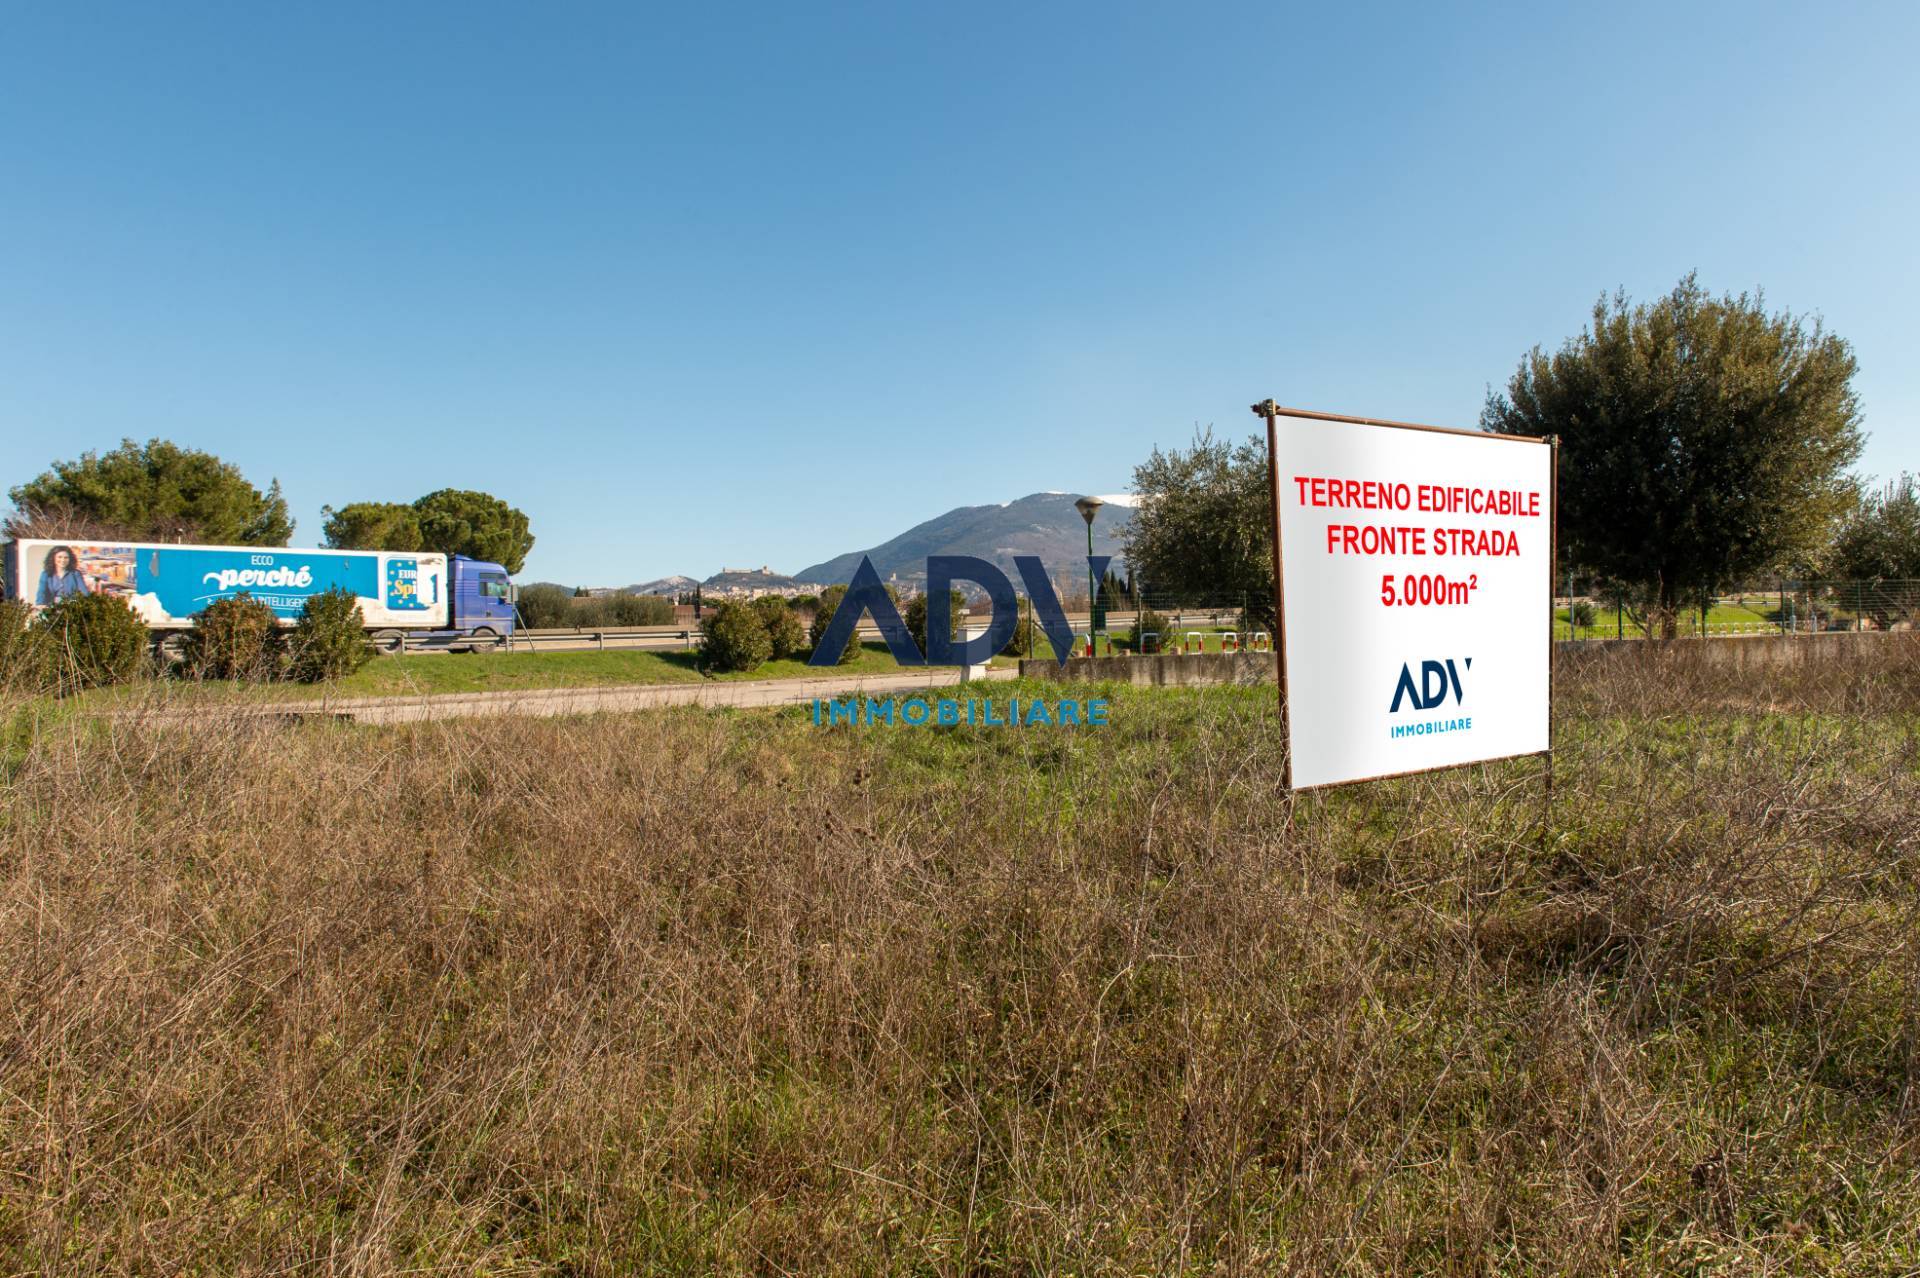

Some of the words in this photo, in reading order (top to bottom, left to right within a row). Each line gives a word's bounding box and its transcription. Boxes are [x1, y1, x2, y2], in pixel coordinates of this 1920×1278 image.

[1294, 477, 1411, 511] TERRENO
[1418, 484, 1540, 517] EDIFICABILE
[1327, 525, 1427, 556] FRONTE
[1433, 528, 1521, 557] STRADA
[251, 555, 274, 566] ECCO
[203, 565, 314, 591] perché
[1389, 657, 1473, 713] ADV
[1391, 717, 1472, 739] IMMOBILIARE
